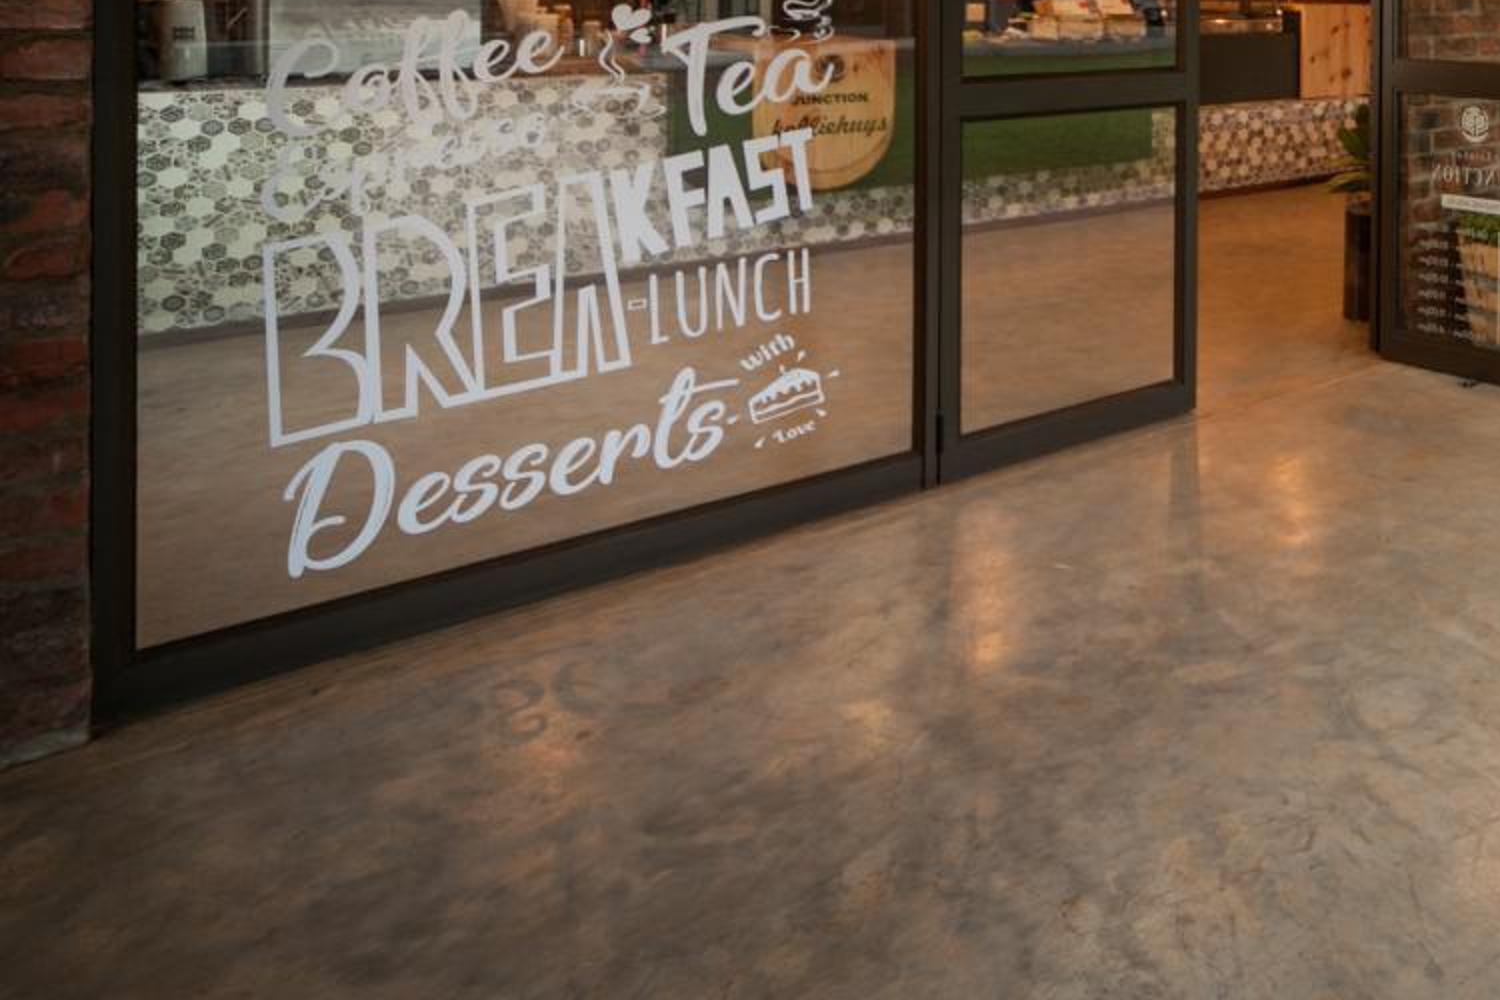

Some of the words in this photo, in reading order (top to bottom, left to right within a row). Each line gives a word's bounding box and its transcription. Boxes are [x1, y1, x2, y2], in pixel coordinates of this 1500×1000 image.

[266, 9, 564, 137] Coffee
[660, 14, 834, 137] Tea
[740, 333, 795, 371] with
[283, 367, 740, 579] Desserts
